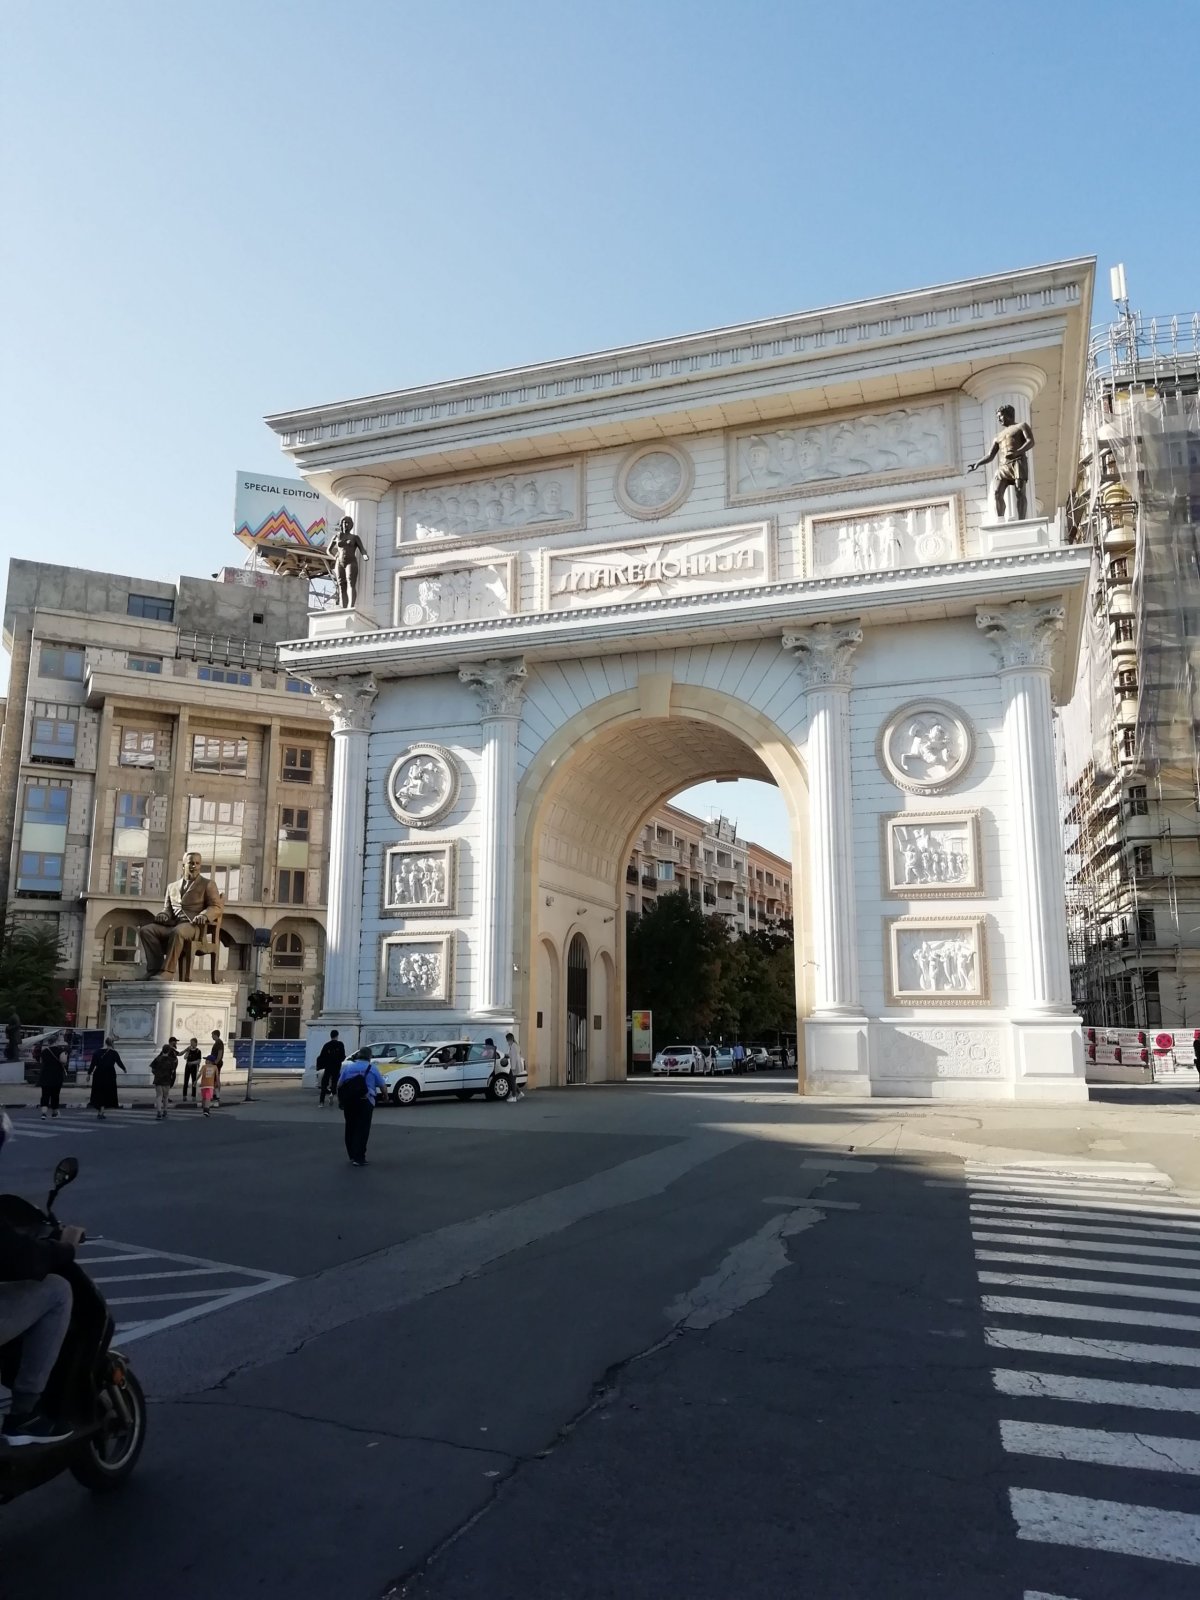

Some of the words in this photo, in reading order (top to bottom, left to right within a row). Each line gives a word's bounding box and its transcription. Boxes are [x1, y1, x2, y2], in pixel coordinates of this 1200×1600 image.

[244, 482, 280, 494] SPECIAL
[282, 488, 320, 500] EDITION
[558, 548, 755, 592] МАКЕДОНИЈА
